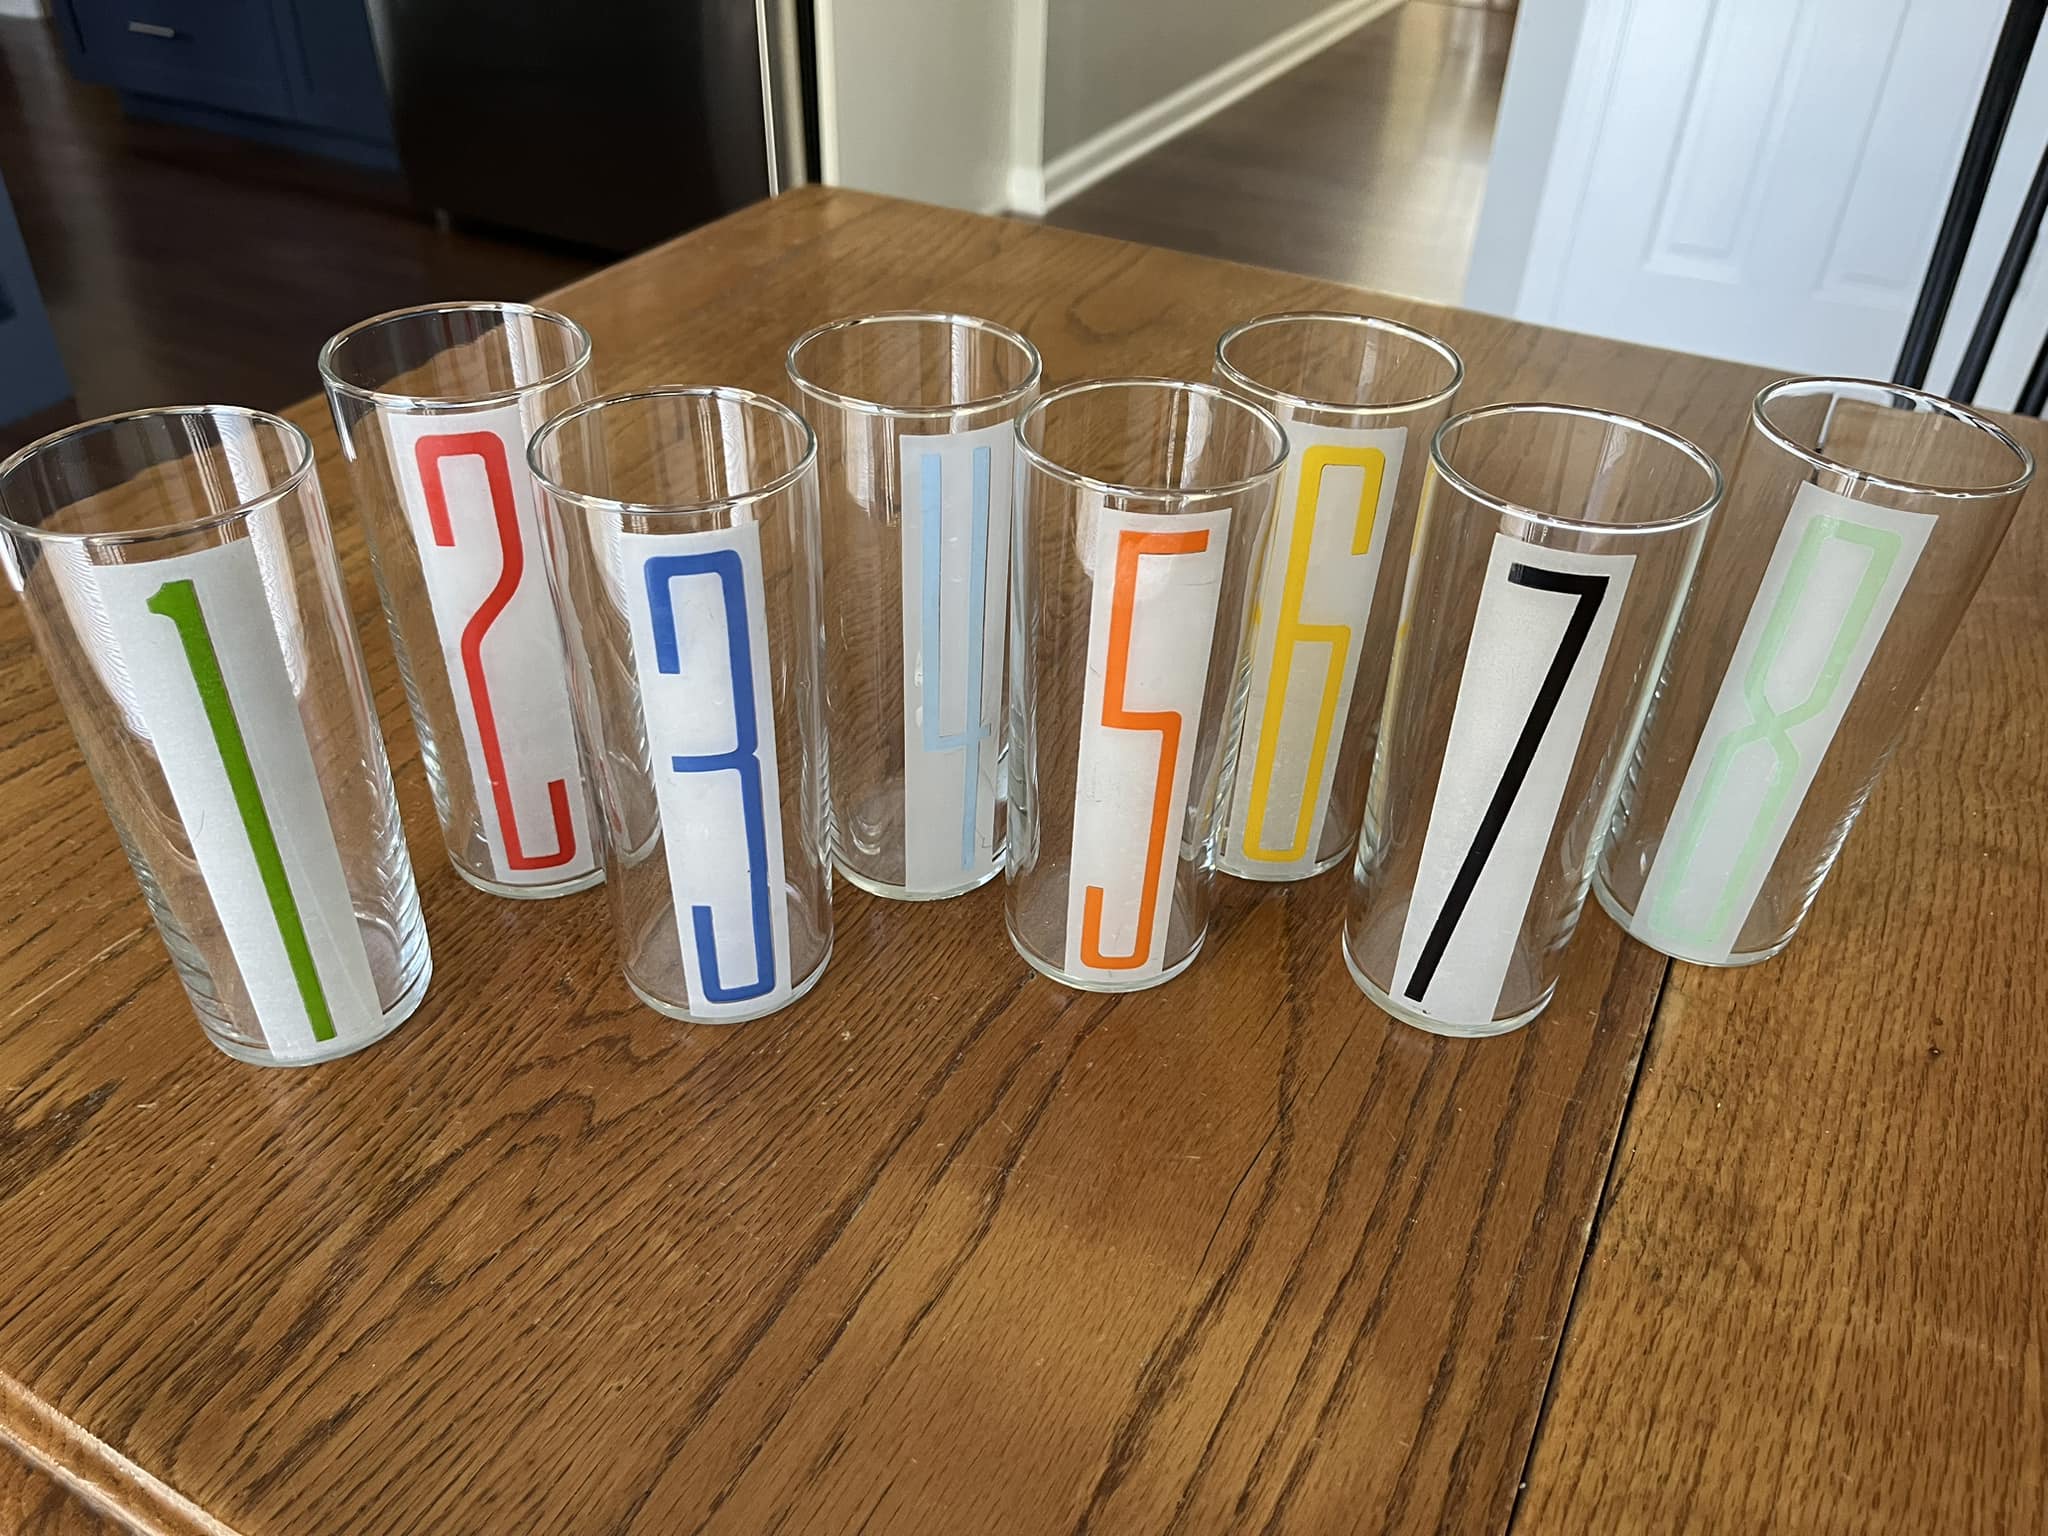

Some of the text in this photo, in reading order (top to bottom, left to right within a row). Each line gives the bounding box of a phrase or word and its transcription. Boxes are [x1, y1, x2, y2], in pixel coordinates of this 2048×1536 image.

[146, 580, 337, 1042] 1
[415, 430, 576, 870] 2
[643, 549, 776, 1004] 3
[920, 446, 992, 870] 4
[1080, 528, 1210, 970] 5
[1243, 445, 1386, 863] 6
[1403, 561, 1610, 1002] 7
[1648, 515, 1903, 944] 8
